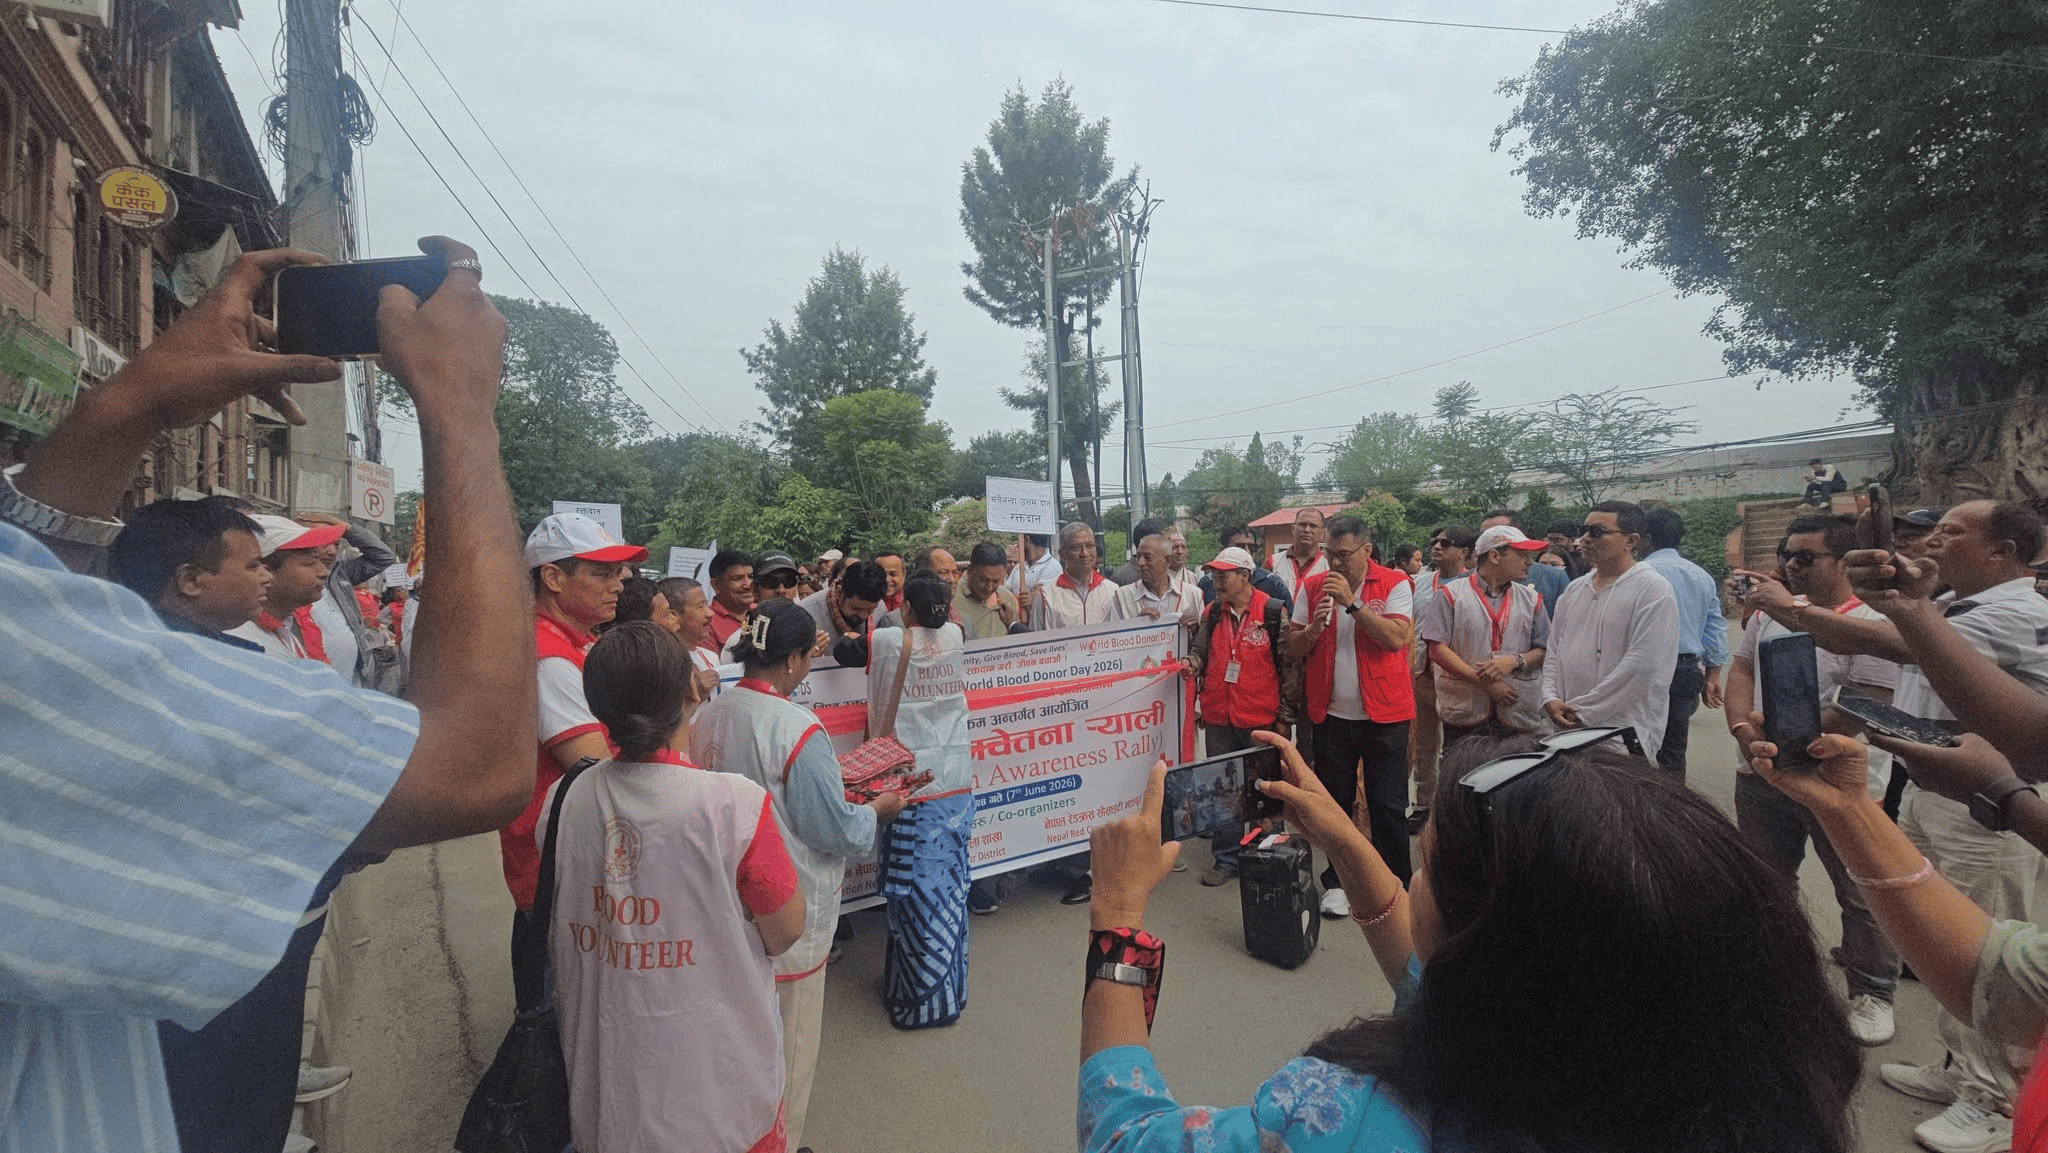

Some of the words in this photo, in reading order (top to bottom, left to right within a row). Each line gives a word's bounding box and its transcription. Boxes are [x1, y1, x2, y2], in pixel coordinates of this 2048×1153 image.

[115, 181, 152, 198] केक
[112, 195, 156, 211] पसल
[1010, 513, 1041, 524] रक्तदान
[1111, 637, 1134, 648] Blood
[1136, 634, 1159, 644] Donor
[1161, 631, 1175, 642] Day
[963, 656, 981, 667] nity,
[984, 653, 1002, 663] Give
[1004, 650, 1028, 659] Blood,
[1030, 647, 1048, 656] Save
[918, 664, 953, 680] BLOOD
[966, 664, 995, 676] रक्तदान
[1016, 657, 1037, 669] जीवन
[997, 672, 1030, 688] Blood
[1033, 667, 1068, 682] Donor
[1070, 664, 1090, 678] Day
[1094, 658, 1123, 673] 2026)
[991, 707, 1036, 726] अन्तर्गत
[1040, 698, 1089, 717] आयोजित
[989, 747, 1108, 786] Awareness
[1113, 730, 1163, 762] Rally)
[1024, 785, 1047, 797] June
[1050, 777, 1076, 791] 2026)
[998, 797, 1076, 822] Co-organizers
[1044, 816, 1066, 830] नेपाल
[982, 832, 1003, 846] शाखा
[1046, 831, 1069, 844] Nepal
[1070, 828, 1085, 838] Red
[978, 847, 1006, 862] District
[592, 885, 661, 926] BOOD
[568, 922, 696, 971] VOUNTEER
